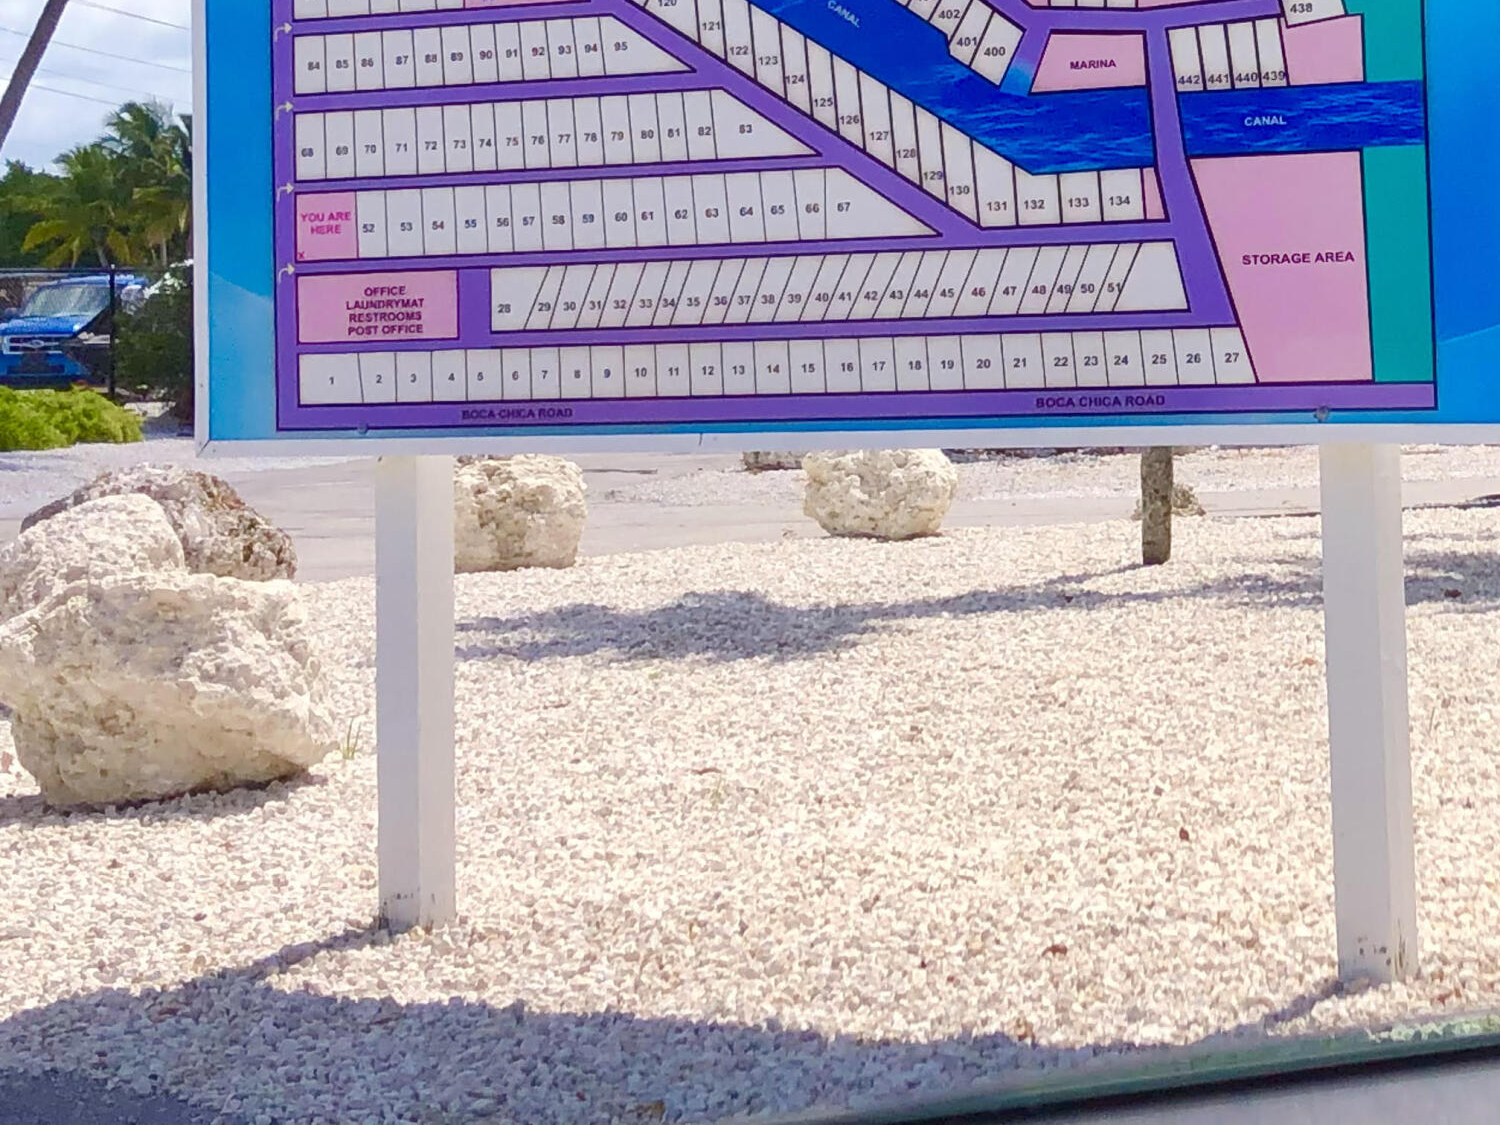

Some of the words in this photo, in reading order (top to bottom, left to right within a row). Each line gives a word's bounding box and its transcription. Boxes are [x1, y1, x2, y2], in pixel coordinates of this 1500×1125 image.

[827, 0, 860, 27] CANAL
[702, 21, 720, 31] 121
[730, 45, 748, 55] 122
[1070, 59, 1116, 69] MARINA
[1178, 75, 1200, 85] 442
[1244, 115, 1286, 127] CANAL
[558, 134, 570, 143] 77
[870, 131, 889, 140] 127
[425, 141, 437, 150] 72
[480, 139, 492, 147] 74
[506, 137, 518, 146] 75
[396, 143, 407, 152] 71
[301, 213, 324, 222] YOU
[328, 211, 351, 220] ARE
[523, 217, 535, 226] 57
[362, 224, 374, 233] 52
[465, 219, 476, 228] 55
[311, 225, 341, 234] HERE
[1242, 253, 1310, 265] STORAGE
[1315, 251, 1354, 262] AREA
[364, 286, 406, 296] OFFICE
[914, 289, 928, 299] 44
[940, 288, 954, 298] 45
[1003, 286, 1016, 295] 47
[864, 291, 878, 301] 42
[346, 298, 424, 310] LAUNDRYMAT
[349, 312, 421, 322] RESTROOMS
[348, 326, 378, 335] POST
[382, 324, 423, 334] OFFICE
[1014, 358, 1026, 368] 21
[1054, 357, 1068, 367] 22
[1114, 355, 1128, 365] 24
[1152, 354, 1166, 364] 25
[1225, 353, 1239, 363] 27
[702, 366, 714, 375] 12
[767, 365, 779, 373] 14
[802, 363, 815, 373] 15
[872, 361, 886, 371] 17
[478, 372, 483, 381] 5
[542, 370, 548, 379] 7
[668, 367, 678, 376] 11
[376, 375, 382, 383] 2
[1036, 397, 1075, 408] BOCA
[1126, 395, 1165, 406] ROAD
[539, 408, 572, 417] ROAD
